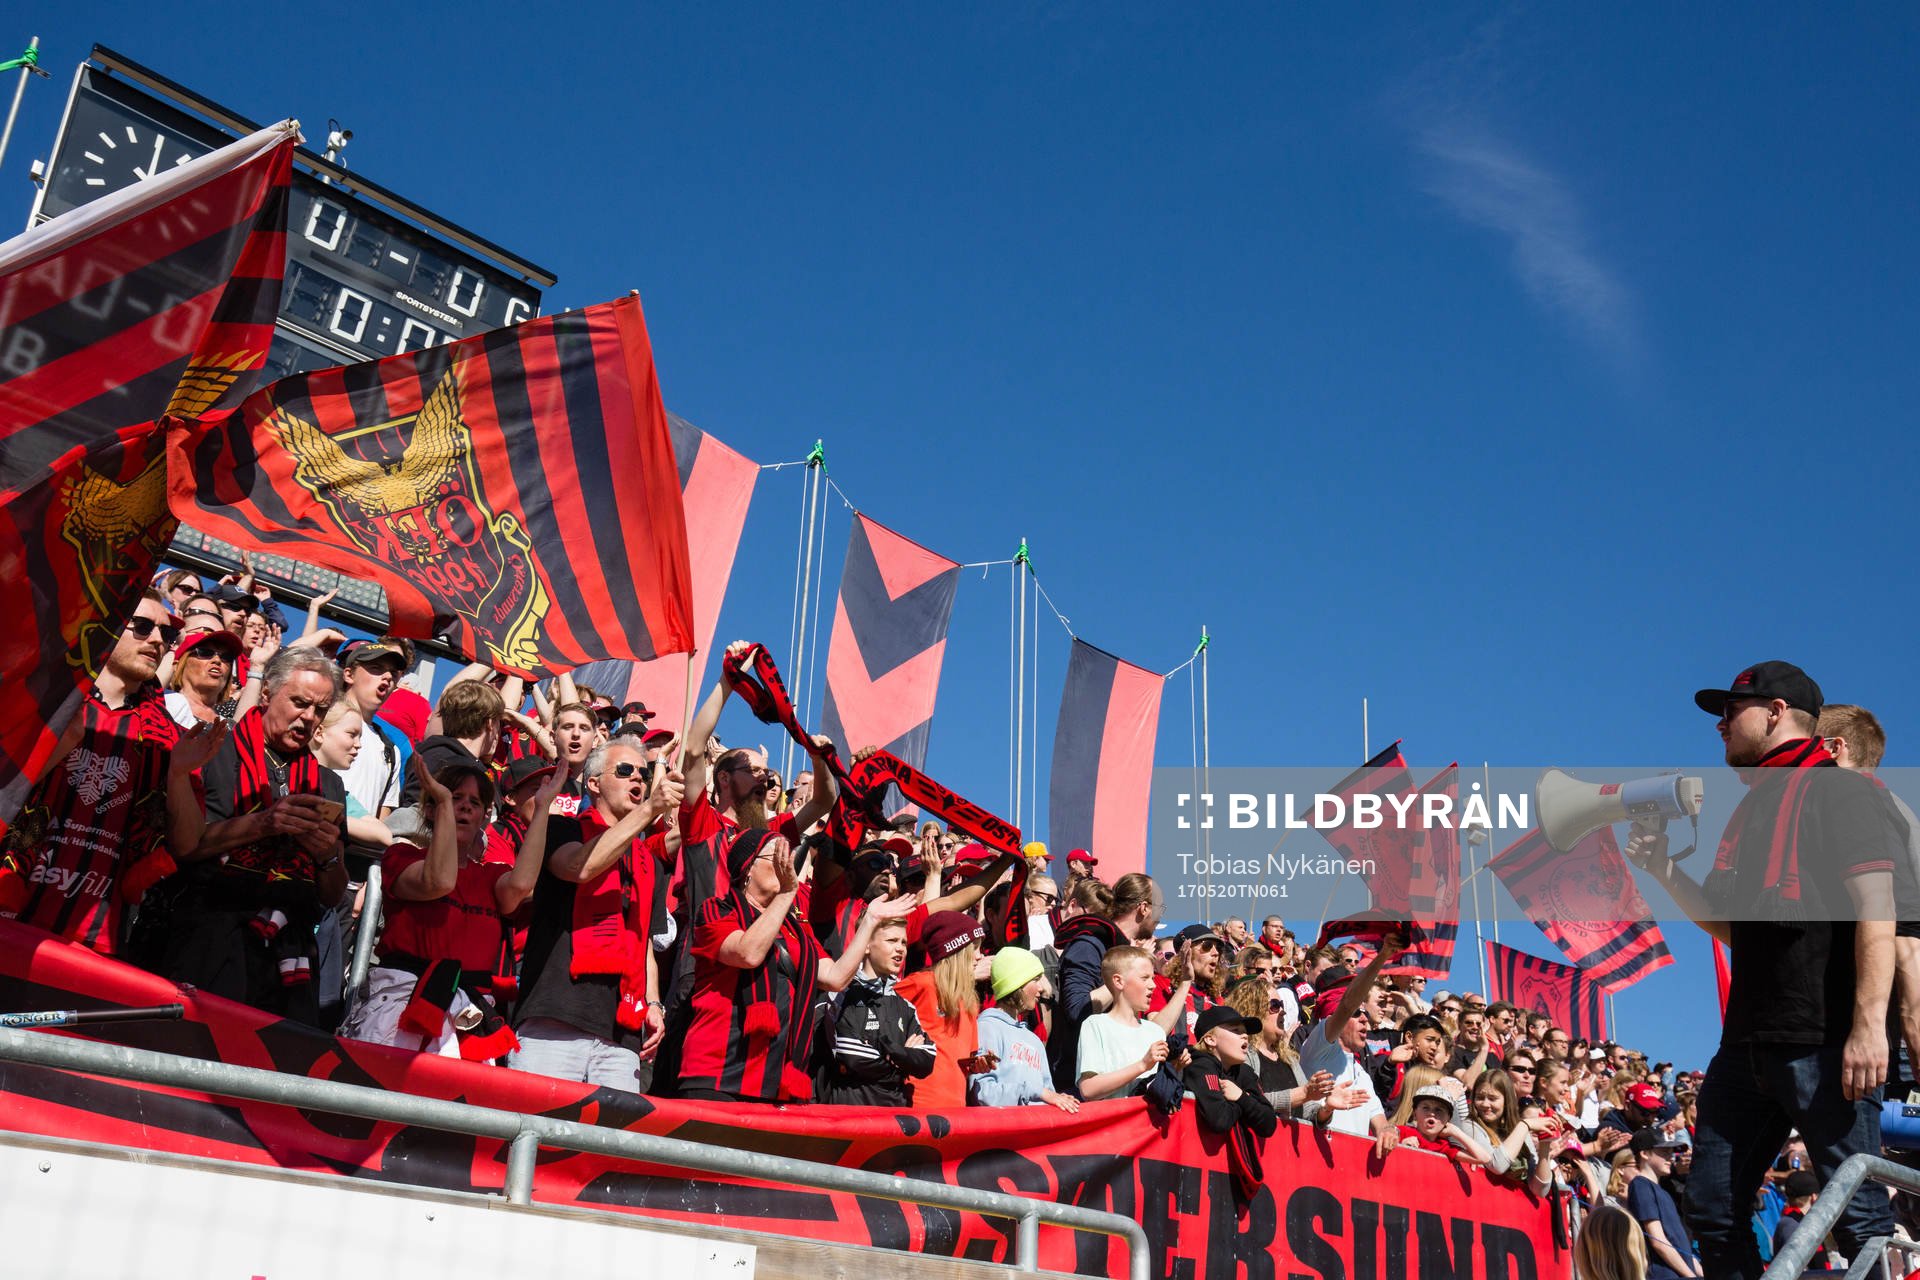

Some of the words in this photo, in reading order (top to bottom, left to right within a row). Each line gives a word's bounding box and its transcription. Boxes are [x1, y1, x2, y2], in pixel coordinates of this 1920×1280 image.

[396, 291, 458, 325] SPORTSYSTEM
[29, 863, 113, 899] asyfill
[944, 933, 970, 952] HOME
